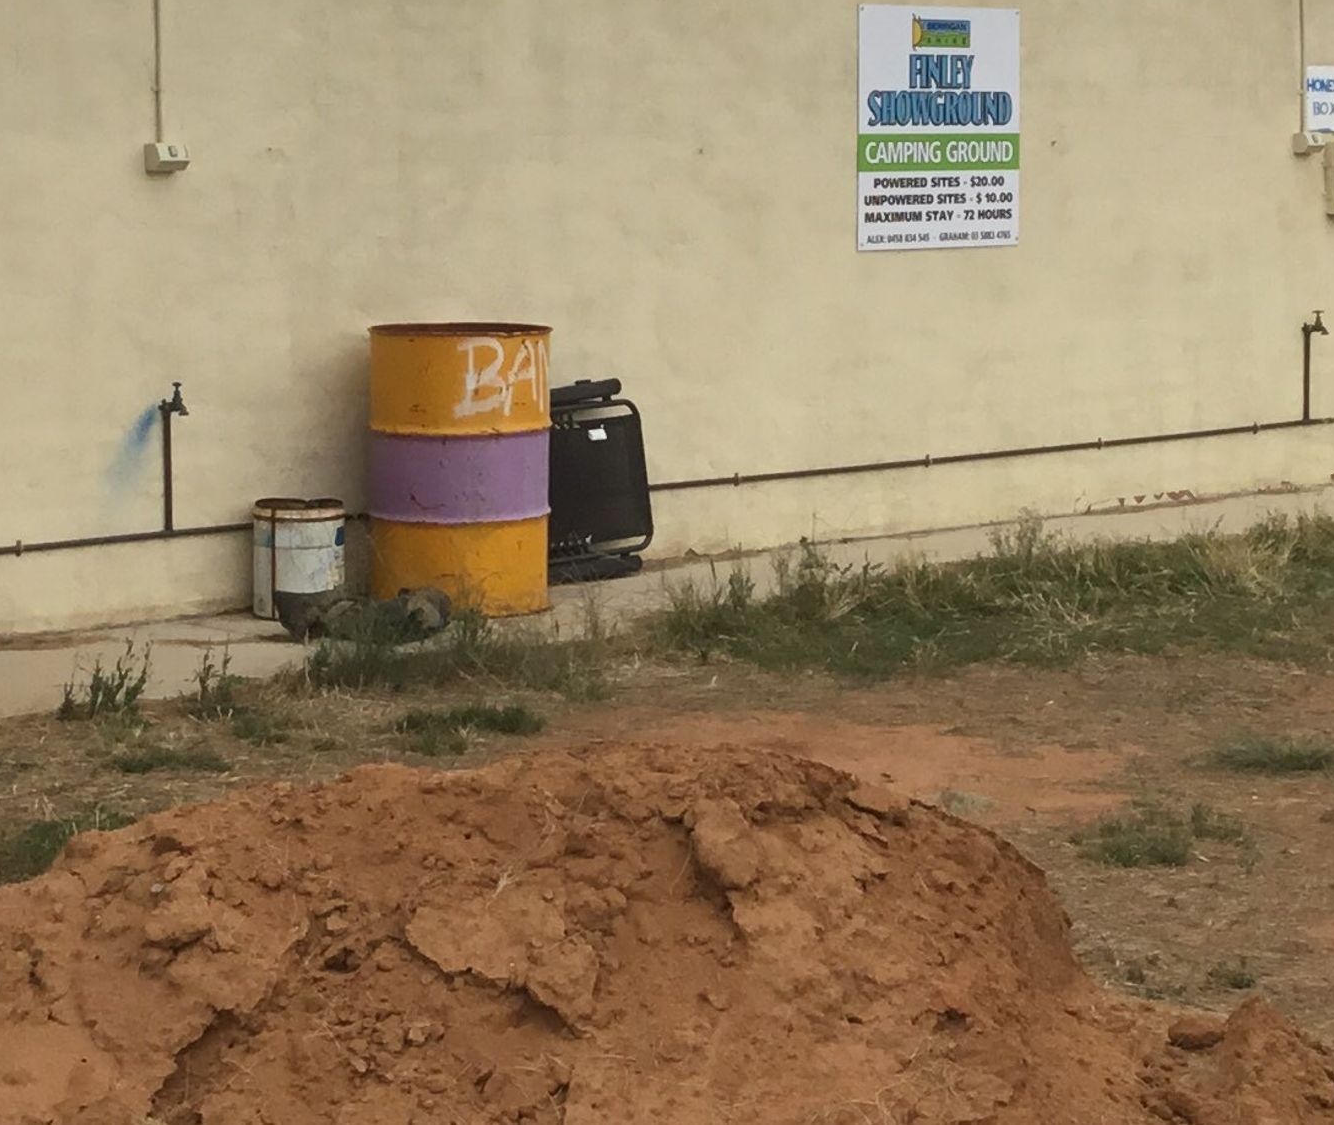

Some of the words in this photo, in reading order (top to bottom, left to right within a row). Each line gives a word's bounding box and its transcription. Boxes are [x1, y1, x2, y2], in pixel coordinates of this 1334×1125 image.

[909, 53, 975, 90] FINLEY
[867, 89, 1013, 126] SHOWGROUND
[865, 141, 942, 164] CAMPING
[946, 140, 1014, 163] GROUND
[873, 177, 927, 188] POWERED
[930, 176, 960, 187] SITES
[970, 175, 1005, 187] $20.00
[864, 194, 934, 206] UNPOWERED
[936, 193, 967, 204] SITES
[984, 191, 1014, 203] 10.00
[864, 210, 923, 223] MAXIMUM
[925, 209, 955, 222] STAY
[963, 209, 976, 220] 72
[978, 208, 1013, 220] HOURS
